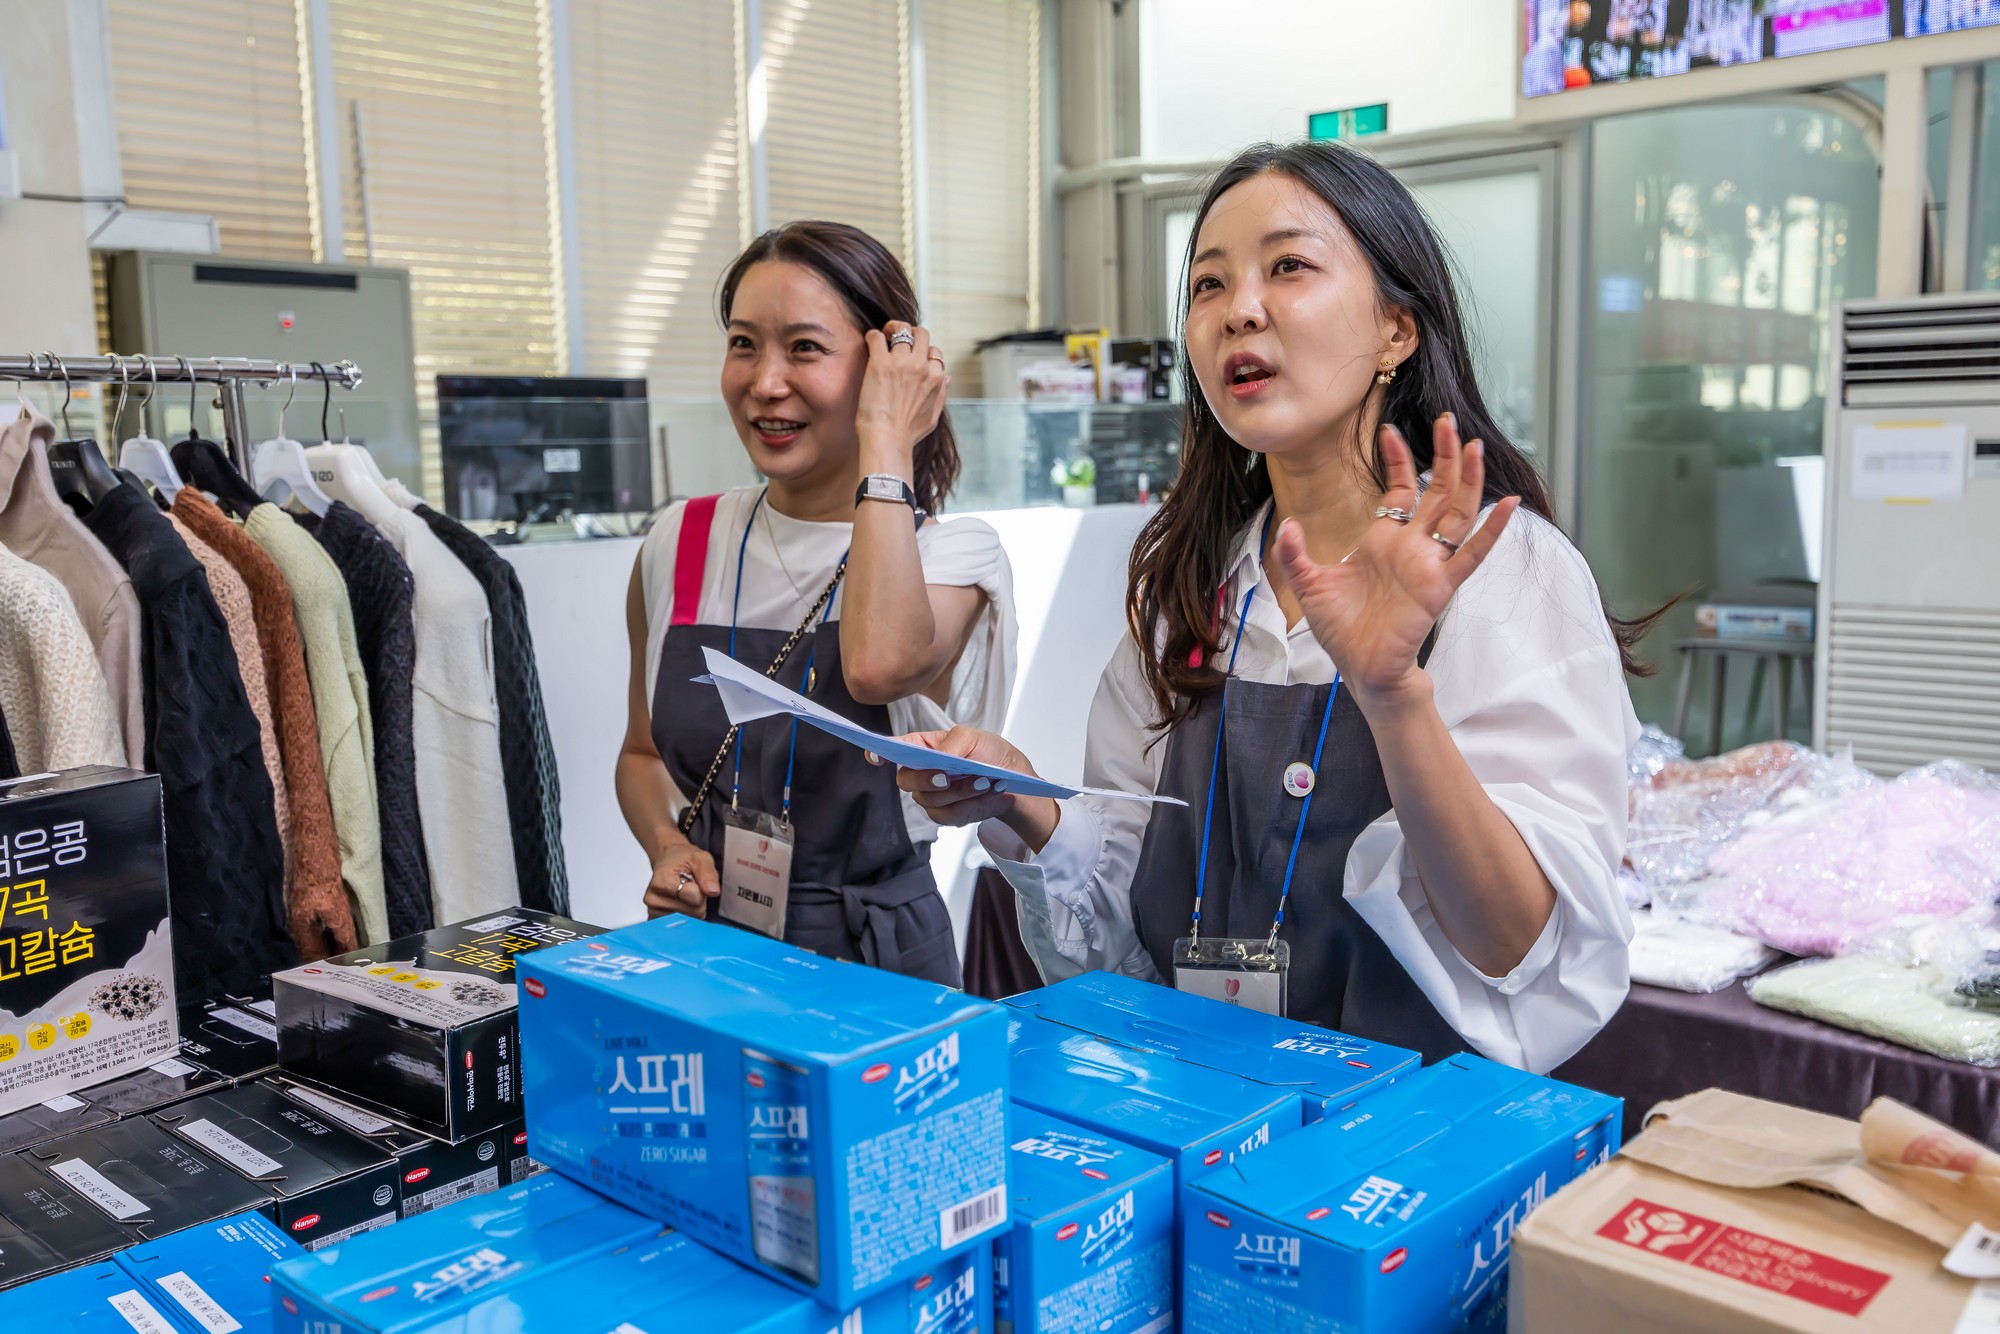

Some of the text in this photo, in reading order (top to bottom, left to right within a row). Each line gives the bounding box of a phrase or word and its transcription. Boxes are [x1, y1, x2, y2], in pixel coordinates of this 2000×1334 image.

[604, 1035, 648, 1049] LIVE VOLT
[1272, 1038, 1370, 1059] 스프레
[893, 1031, 960, 1105] 스프레
[608, 1052, 706, 1117] 스프레
[750, 1105, 809, 1139] 스프레
[515, 1134, 528, 1144] Han
[1010, 1137, 1116, 1166] 스프레
[640, 1146, 708, 1163] ZERO SUGAR
[1204, 1150, 1222, 1165] Hanmi
[407, 1168, 428, 1182] Hanmi
[1340, 1175, 1404, 1225] 스프레
[294, 1215, 319, 1230] Hanmi
[1081, 1189, 1134, 1259] 스프레
[1463, 1224, 1482, 1250] LIVE
[1233, 1232, 1300, 1267] 스프레
[1461, 1170, 1547, 1311] 스프레
[411, 1247, 507, 1301] 스프레
